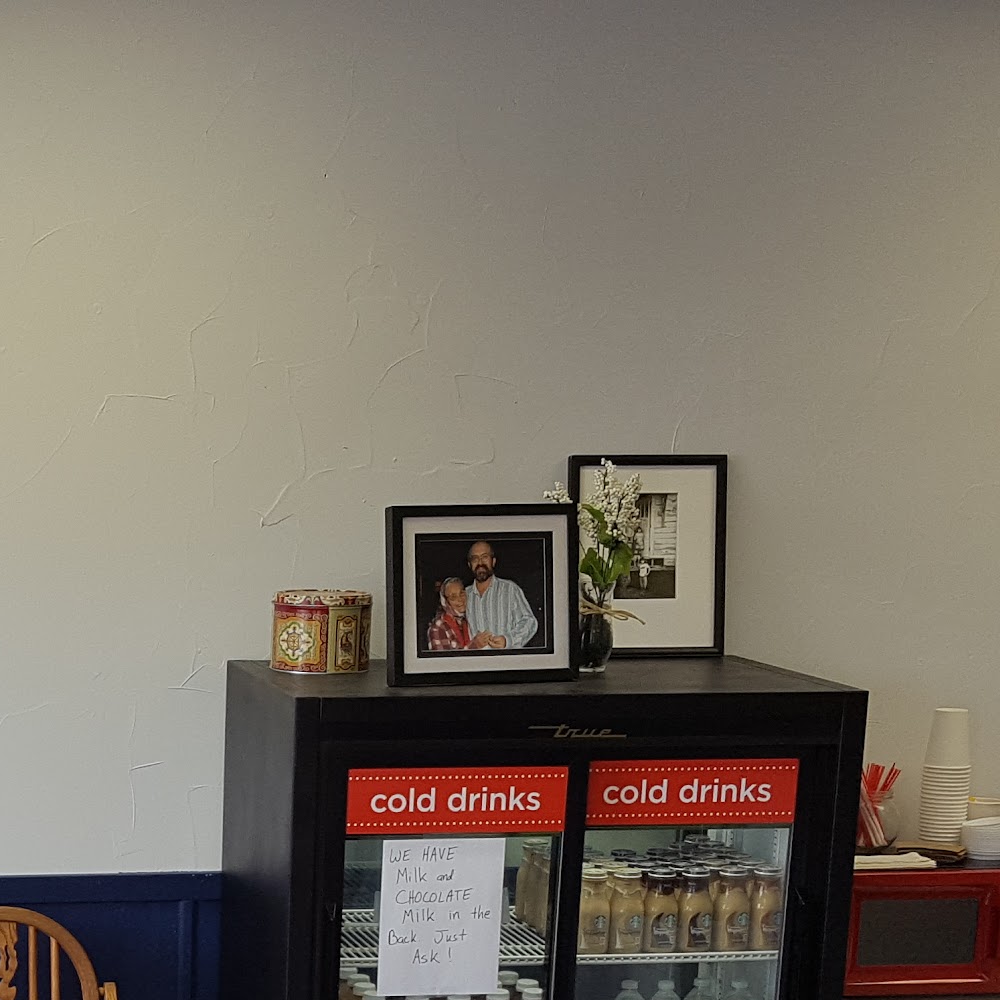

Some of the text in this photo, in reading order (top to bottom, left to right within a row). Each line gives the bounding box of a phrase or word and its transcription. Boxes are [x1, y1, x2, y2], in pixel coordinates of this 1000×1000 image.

[370, 786, 541, 814] cold drinks
[603, 777, 772, 806] cold drinks
[389, 846, 458, 863] WE HAVE
[396, 867, 455, 884] Milk and
[395, 888, 473, 905] CHOCOLATE
[402, 904, 491, 924] Milk in the
[388, 929, 468, 946] Back Just
